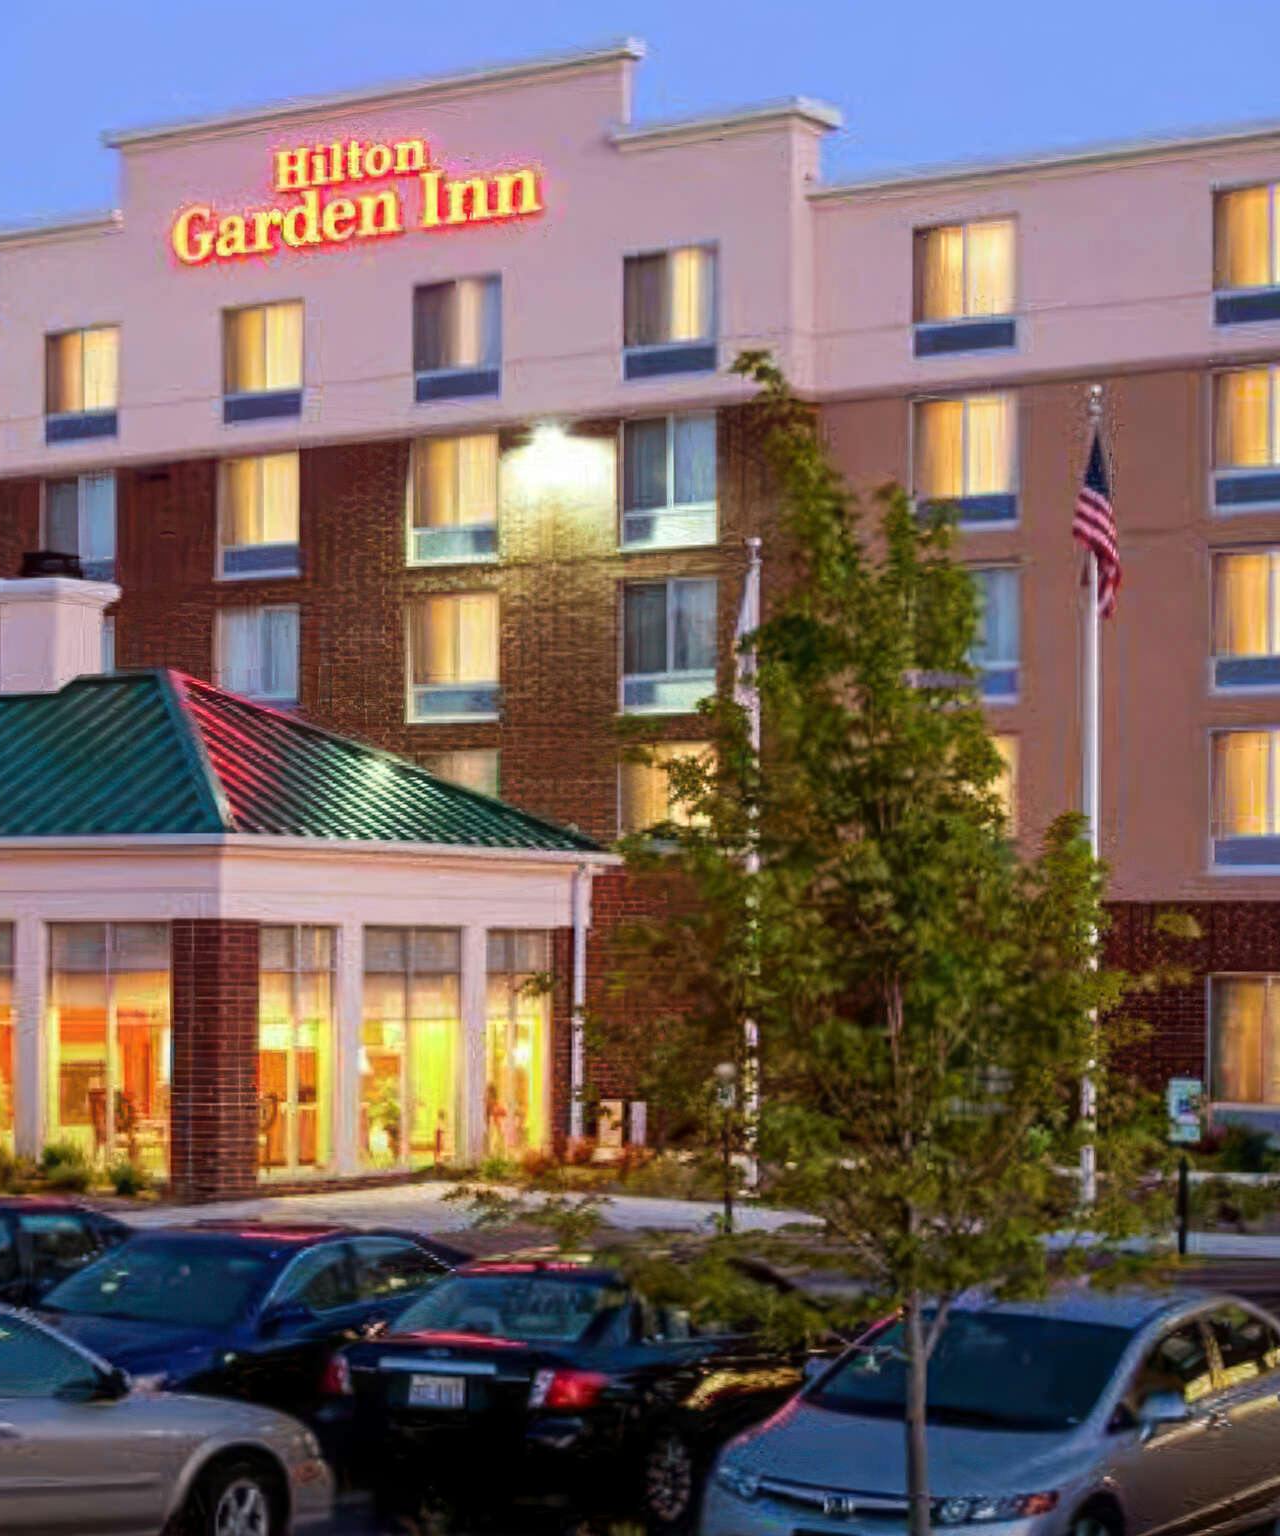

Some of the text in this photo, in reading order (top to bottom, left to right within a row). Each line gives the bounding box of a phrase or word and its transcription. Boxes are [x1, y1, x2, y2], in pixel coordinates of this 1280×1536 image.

[275, 138, 427, 191] Hilton
[172, 168, 543, 263] Garden Inn
